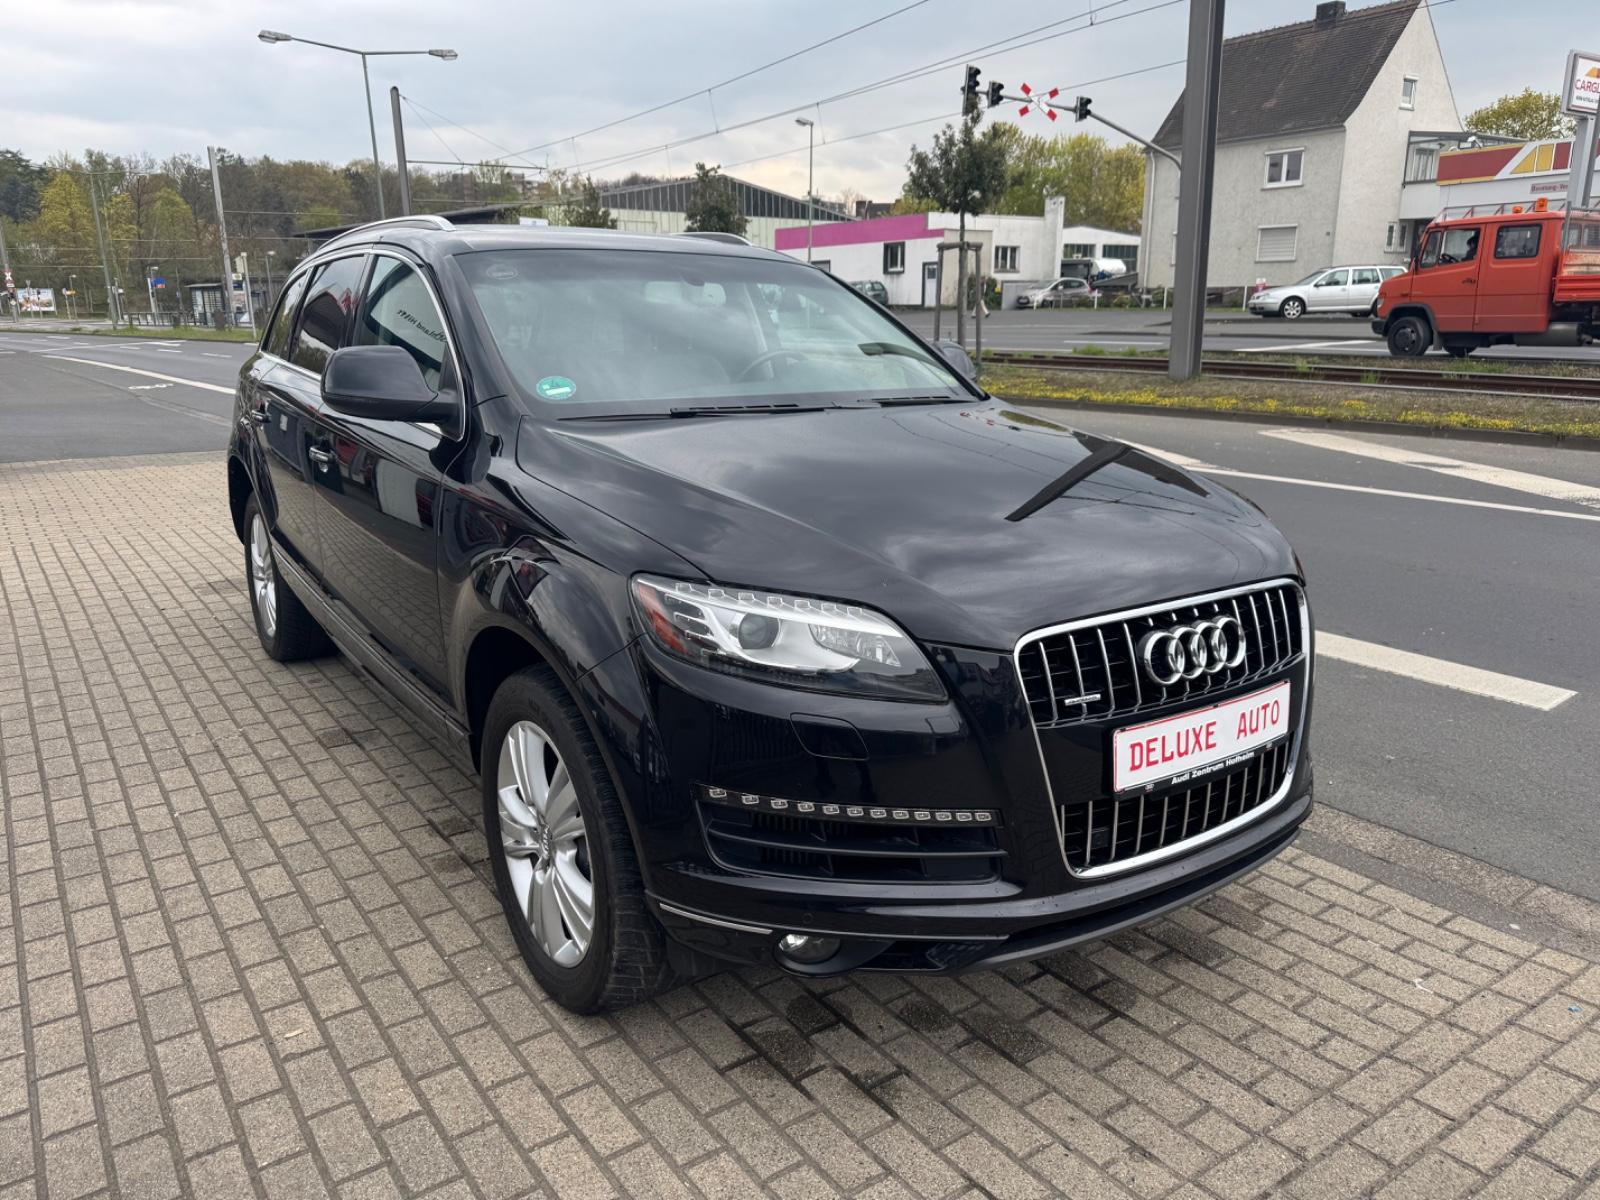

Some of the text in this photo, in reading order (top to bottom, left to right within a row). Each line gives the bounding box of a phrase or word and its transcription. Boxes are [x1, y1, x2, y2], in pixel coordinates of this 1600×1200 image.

[1129, 700, 1280, 771] DELUXE AUTO
[1171, 752, 1255, 785] Audi Zentrum Hofheim
